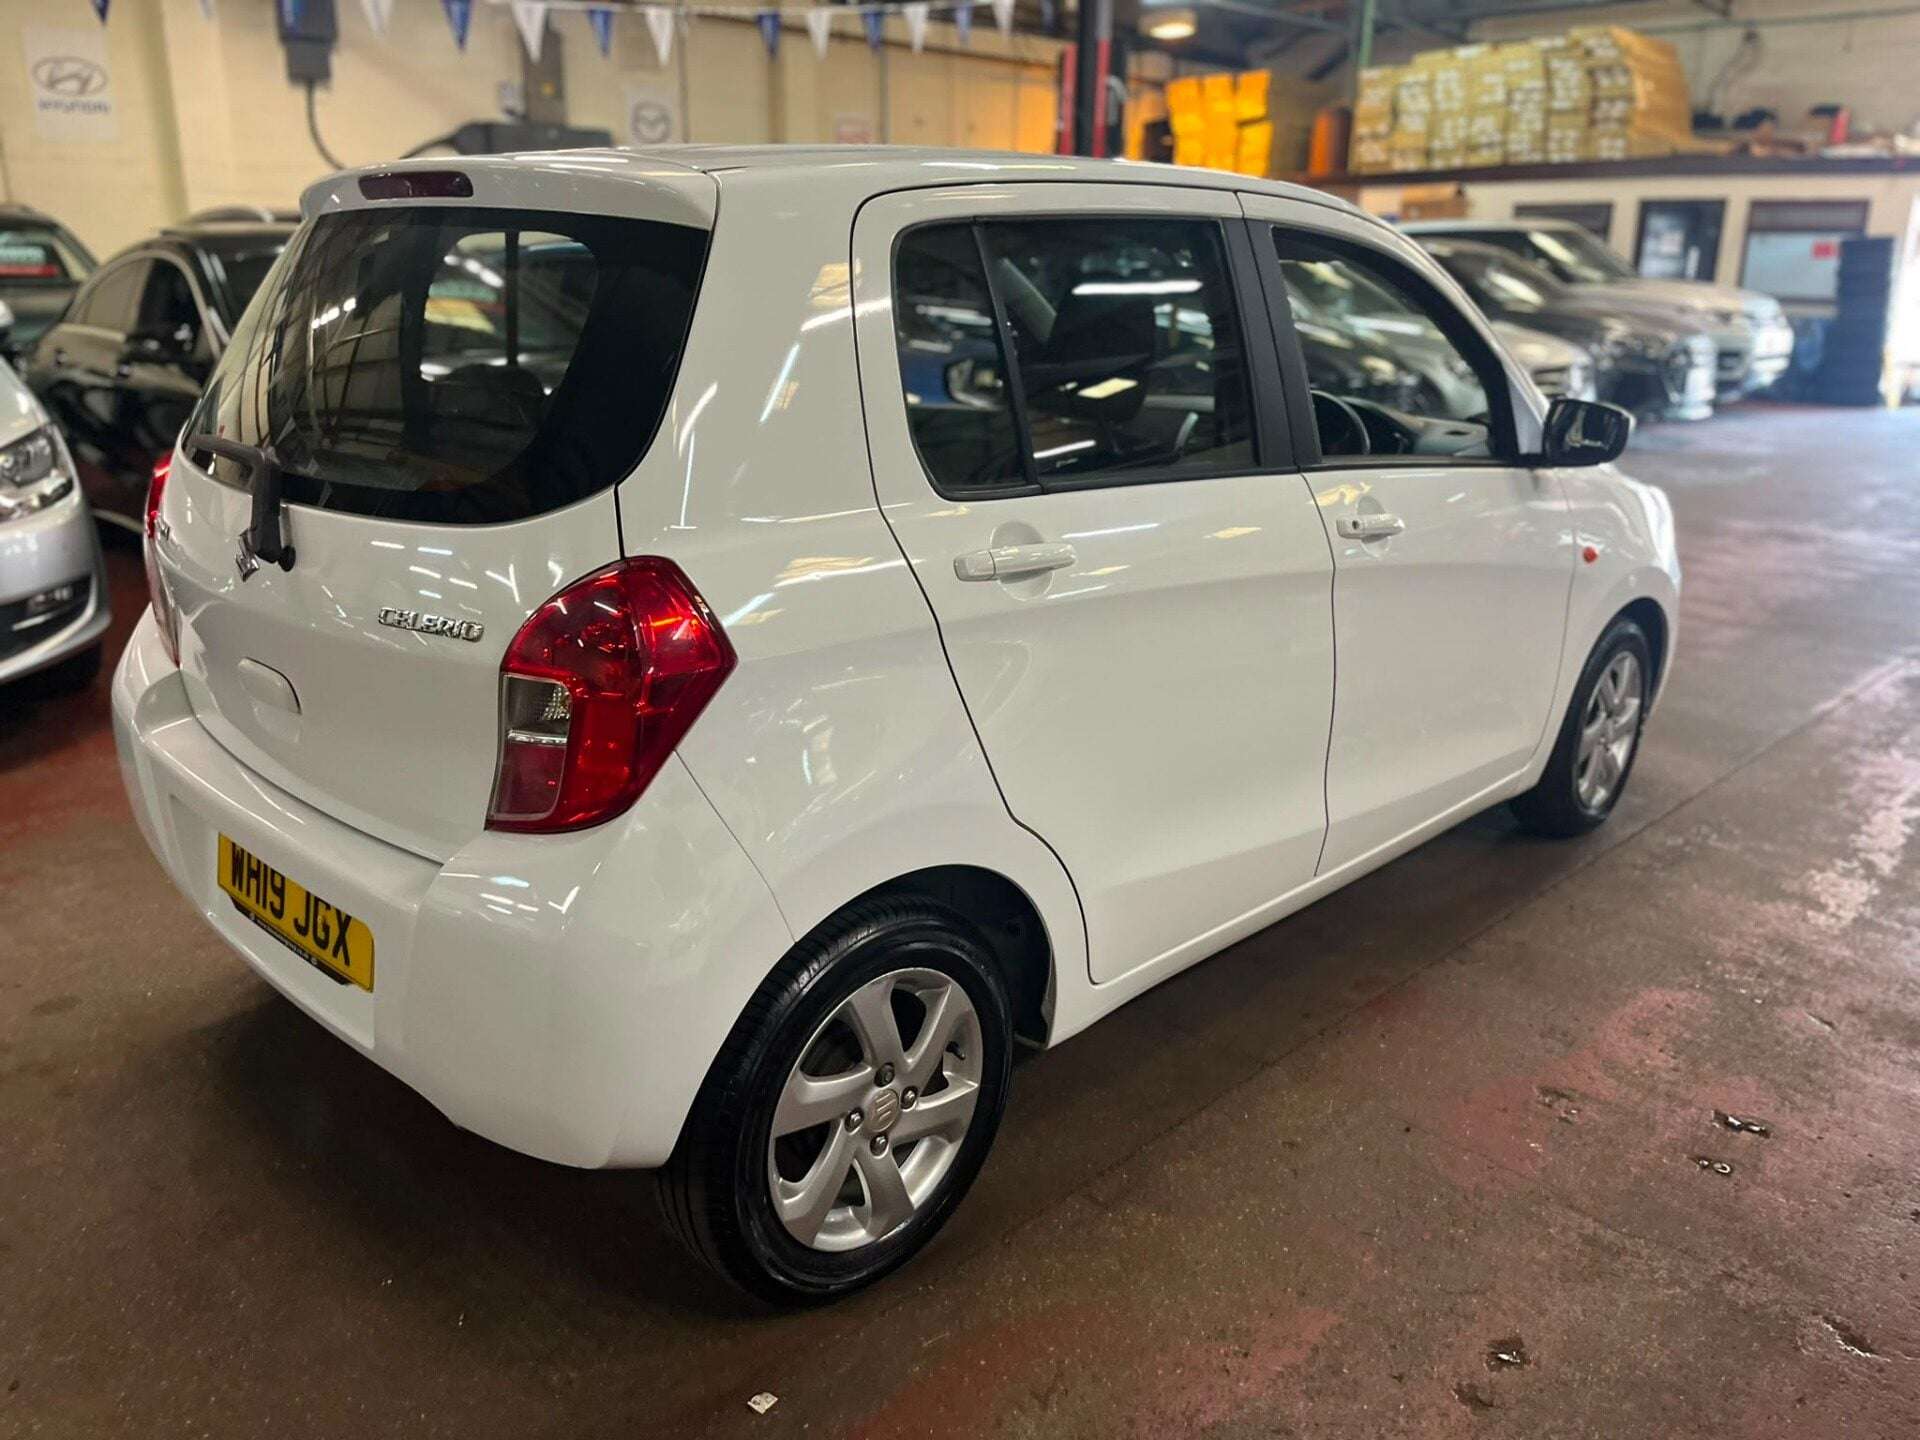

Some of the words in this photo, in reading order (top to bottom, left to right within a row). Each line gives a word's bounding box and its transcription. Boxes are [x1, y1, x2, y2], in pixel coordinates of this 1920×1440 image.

[379, 607, 484, 643] CELERIO
[231, 841, 286, 920] WH19
[293, 890, 353, 967] JGX
